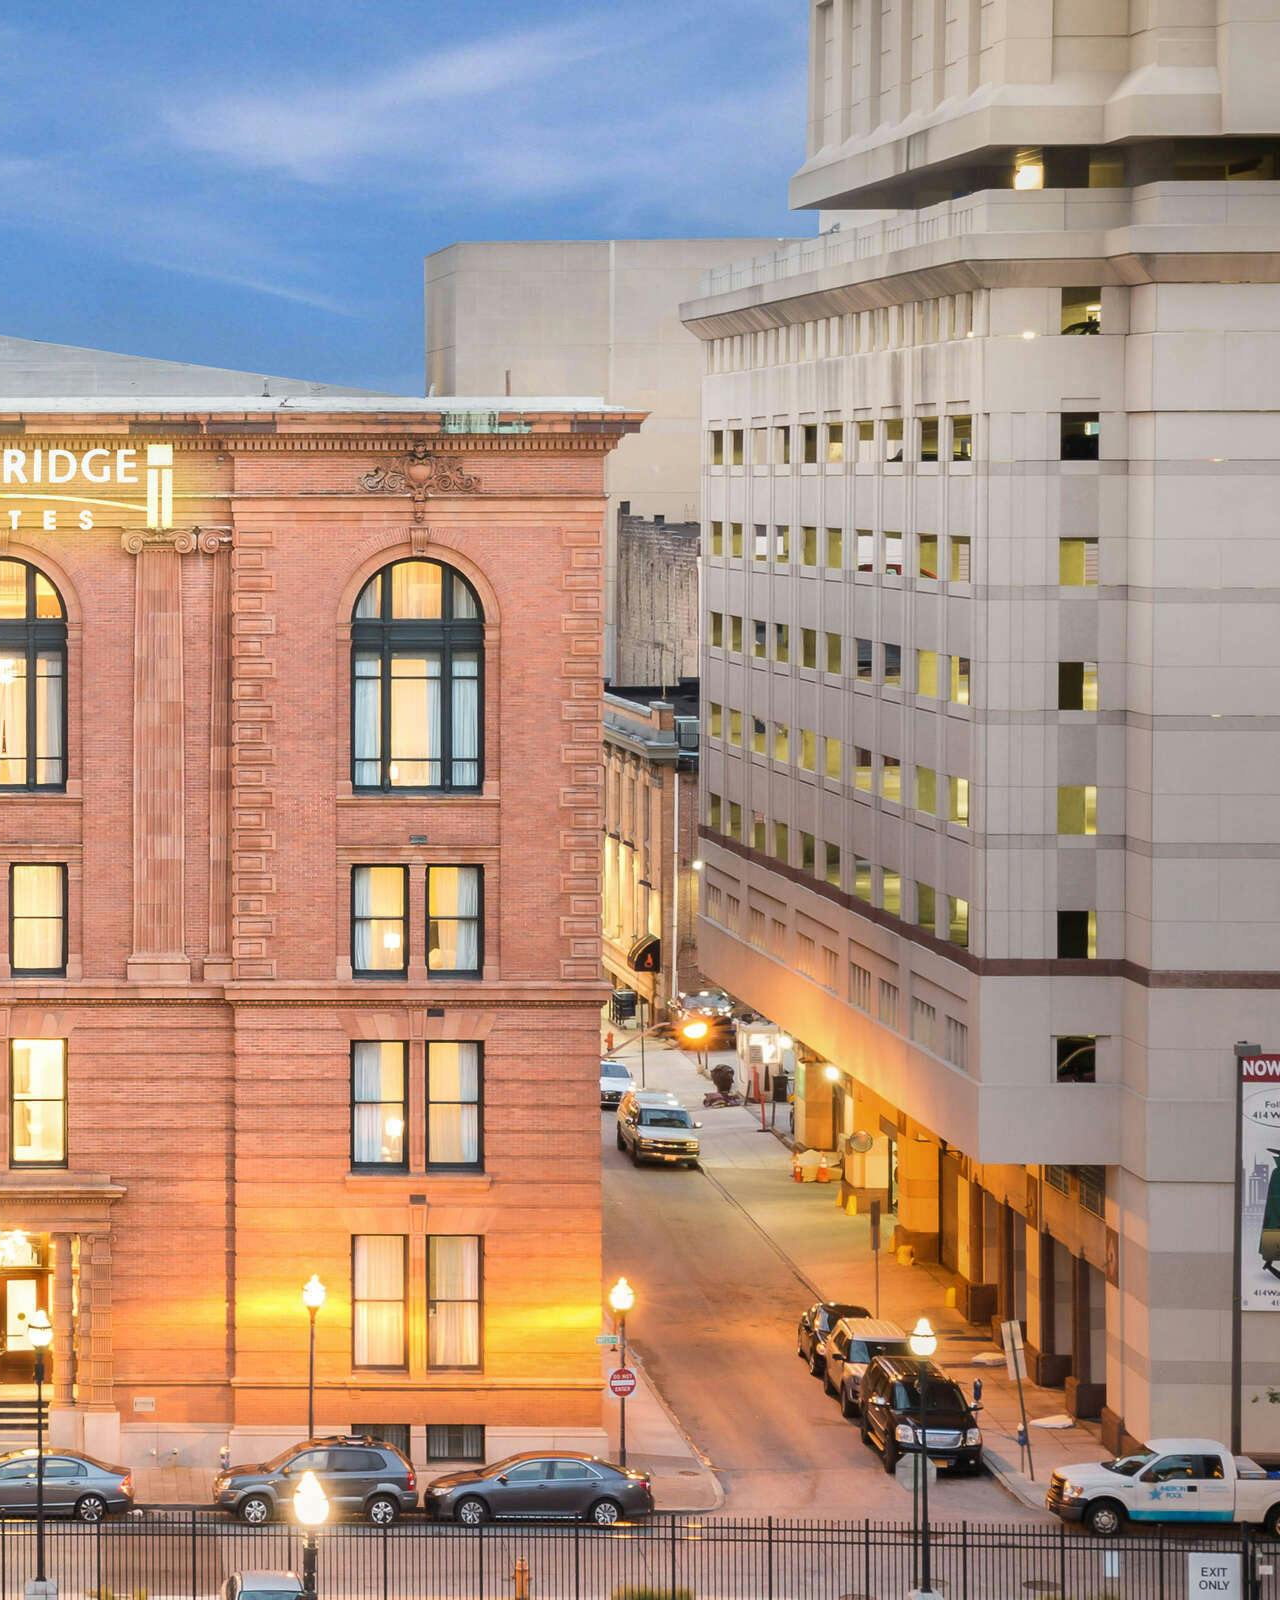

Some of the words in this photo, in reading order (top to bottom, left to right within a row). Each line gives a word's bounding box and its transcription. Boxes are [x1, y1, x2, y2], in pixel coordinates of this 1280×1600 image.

[1243, 1060, 1280, 1076] NOW
[1253, 1111, 1268, 1119] 414
[1201, 1567, 1228, 1577] EXIT
[1199, 1580, 1230, 1590] ONLY
